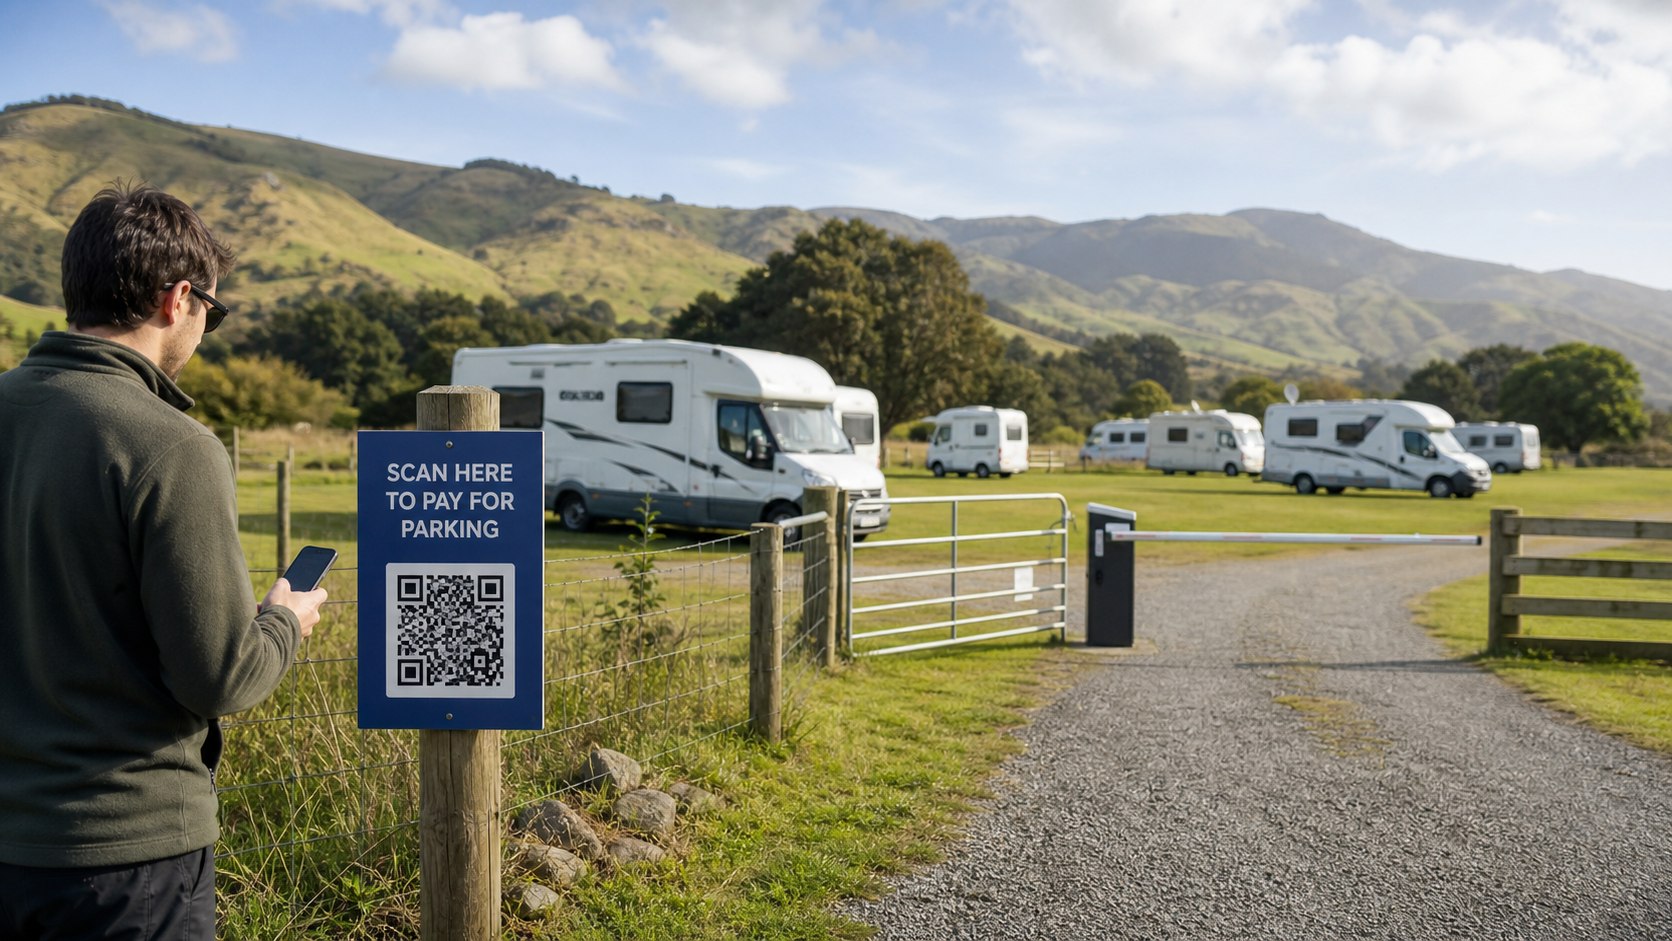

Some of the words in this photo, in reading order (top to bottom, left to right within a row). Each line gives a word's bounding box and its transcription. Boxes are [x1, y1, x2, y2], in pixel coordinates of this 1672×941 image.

[387, 463, 448, 482] SCAN
[455, 463, 513, 482] HERE
[385, 491, 416, 511] TO
[423, 491, 464, 511] PAY
[469, 491, 515, 511] FOR
[401, 519, 499, 539] PARKING
